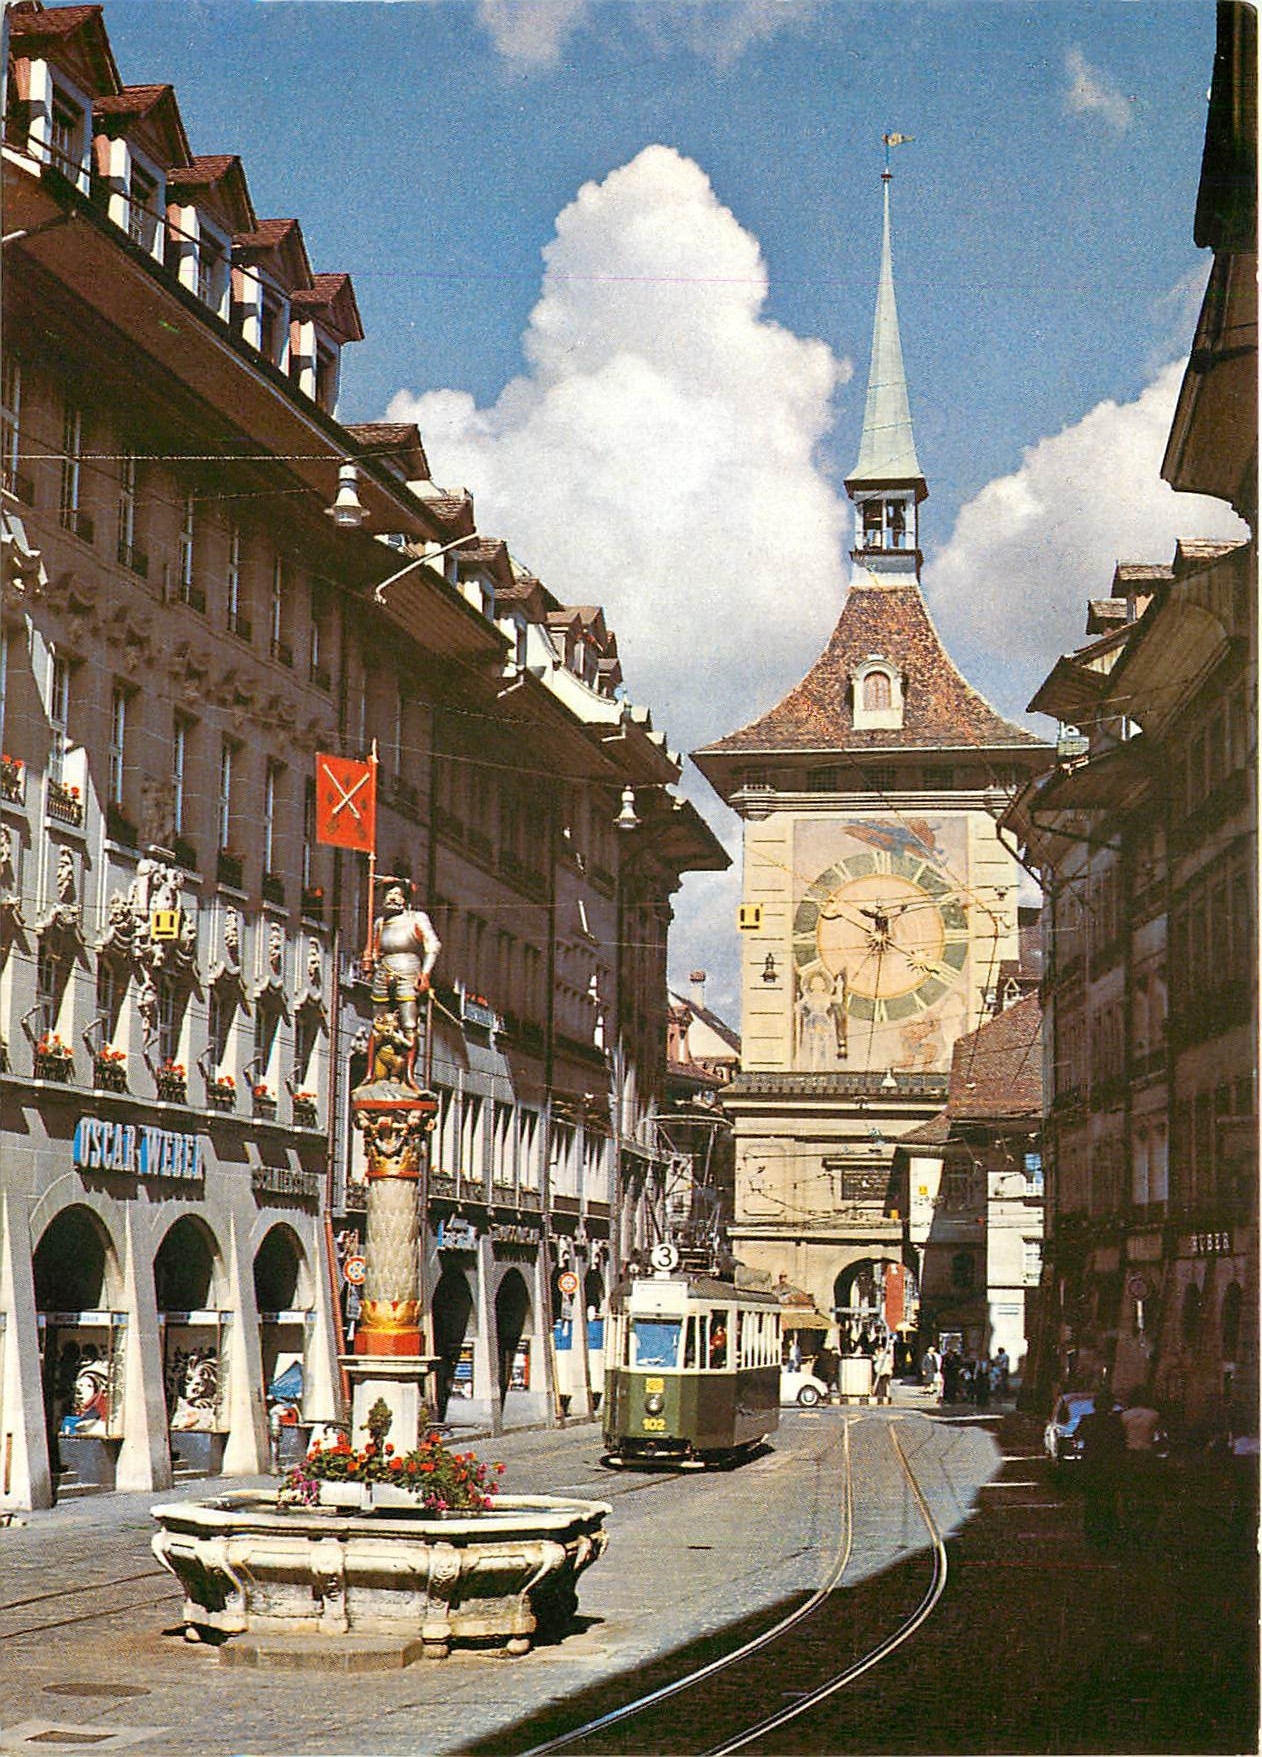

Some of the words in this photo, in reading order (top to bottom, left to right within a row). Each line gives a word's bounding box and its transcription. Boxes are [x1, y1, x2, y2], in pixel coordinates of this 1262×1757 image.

[75, 1116, 136, 1172] OSCAR
[141, 1124, 204, 1180] WEBER
[657, 1246, 672, 1267] 3
[642, 1417, 666, 1431] 102
